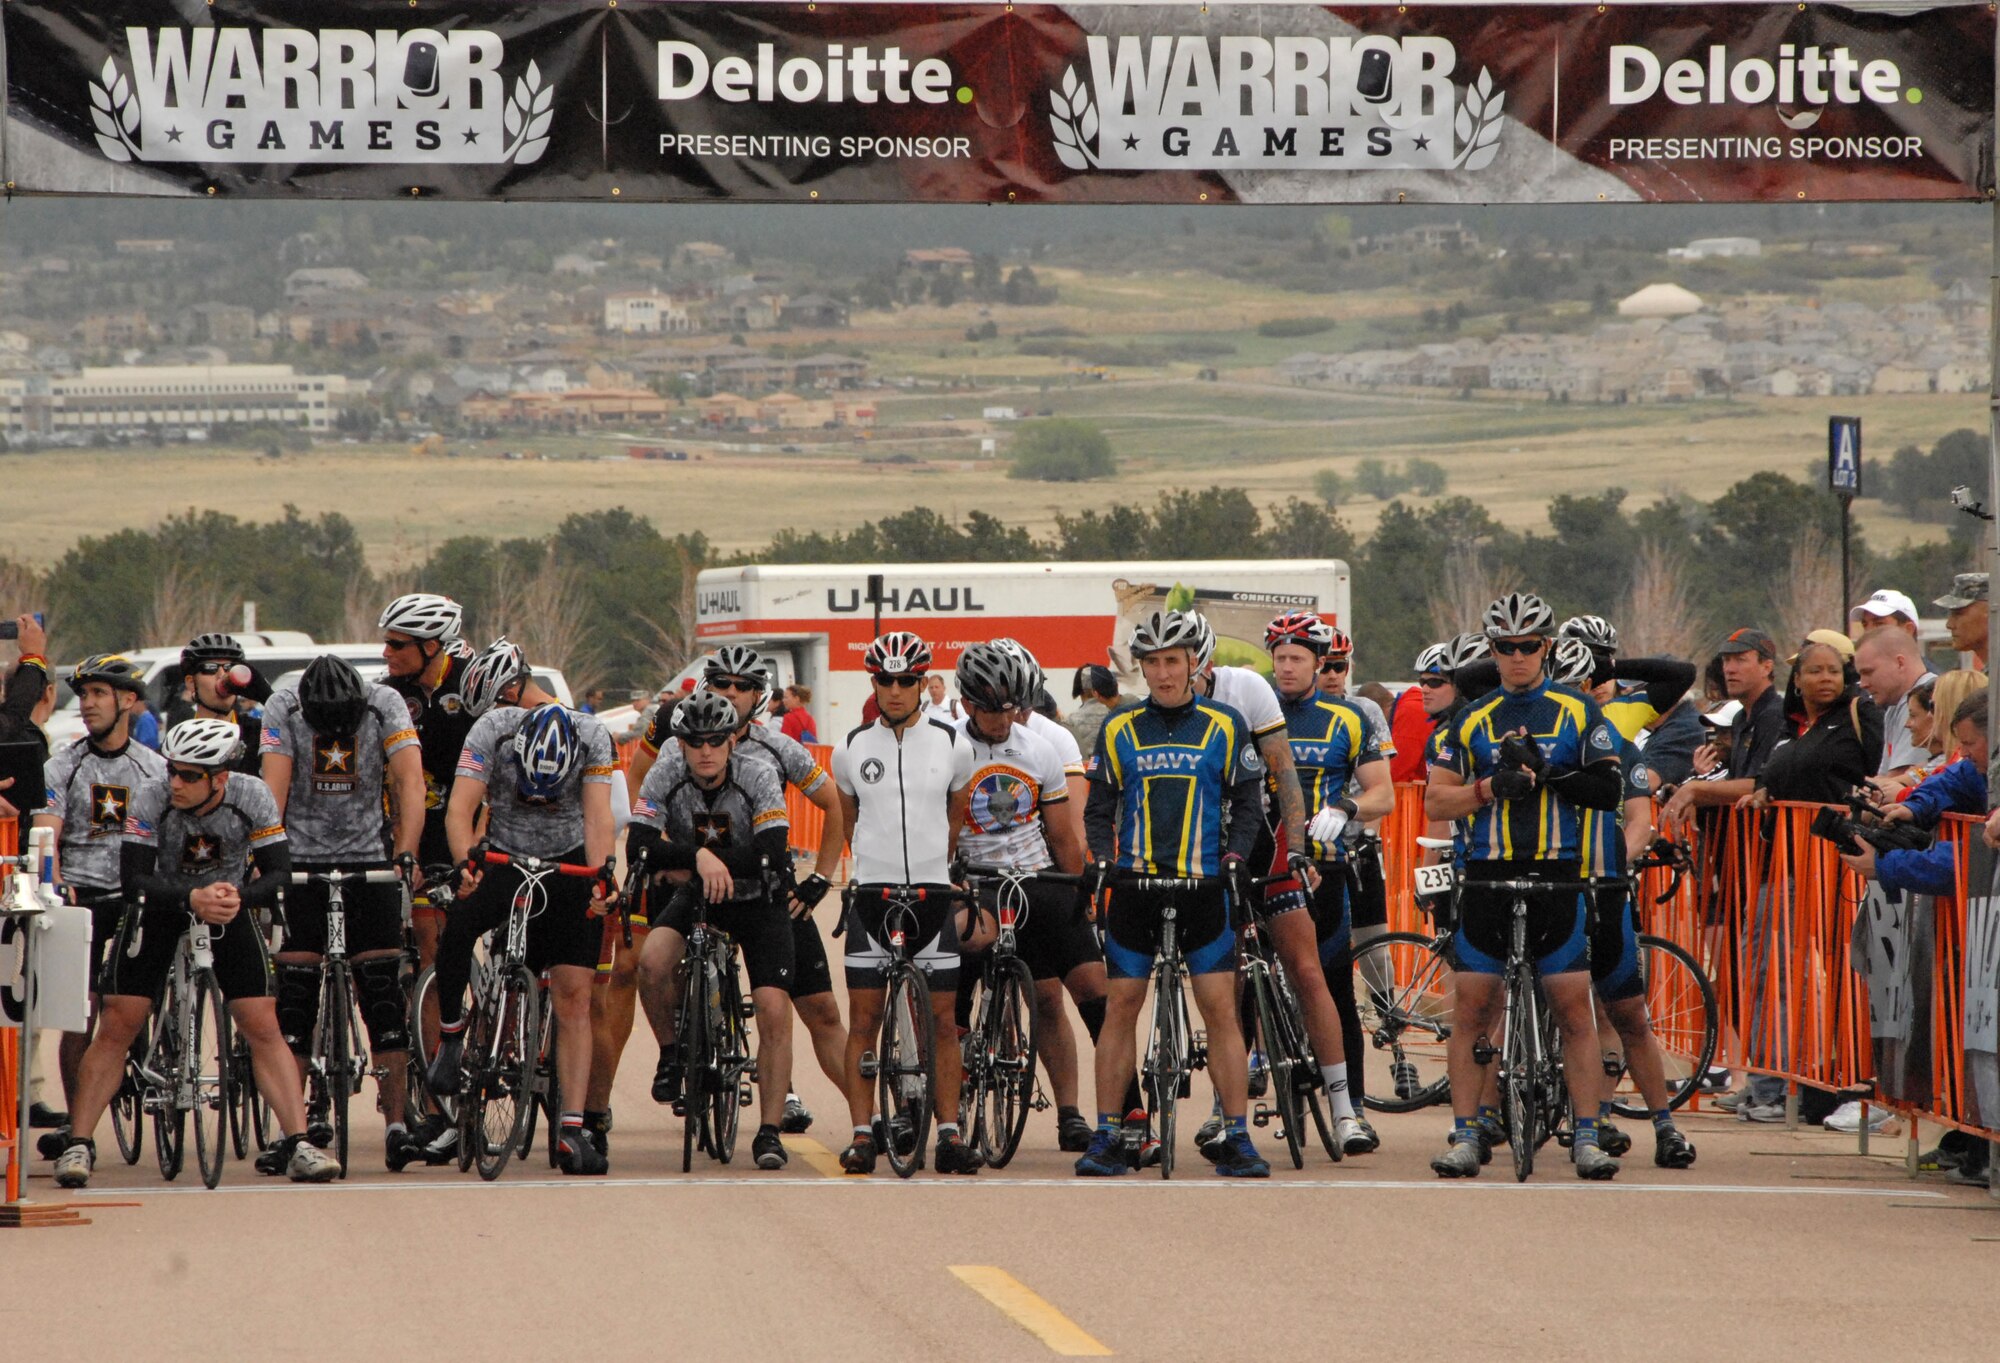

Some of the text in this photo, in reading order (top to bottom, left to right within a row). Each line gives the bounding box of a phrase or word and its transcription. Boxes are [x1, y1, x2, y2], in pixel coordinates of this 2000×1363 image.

[126, 26, 504, 110] WARRIOR
[1086, 34, 1456, 117] WARRIOR
[205, 119, 442, 151] GAMES
[659, 133, 971, 159] PRESENTING SPONSOR
[1161, 126, 1393, 158] GAMES
[1609, 136, 1923, 160] PRESENTING SPONSOR
[1838, 424, 1854, 470] A
[1833, 469, 1849, 487] LOT
[1232, 592, 1316, 605] CONNECTICUT
[888, 659, 902, 670] 278
[1136, 753, 1203, 772] NAVY
[1294, 746, 1330, 763] VY
[1420, 866, 1452, 889] 235
